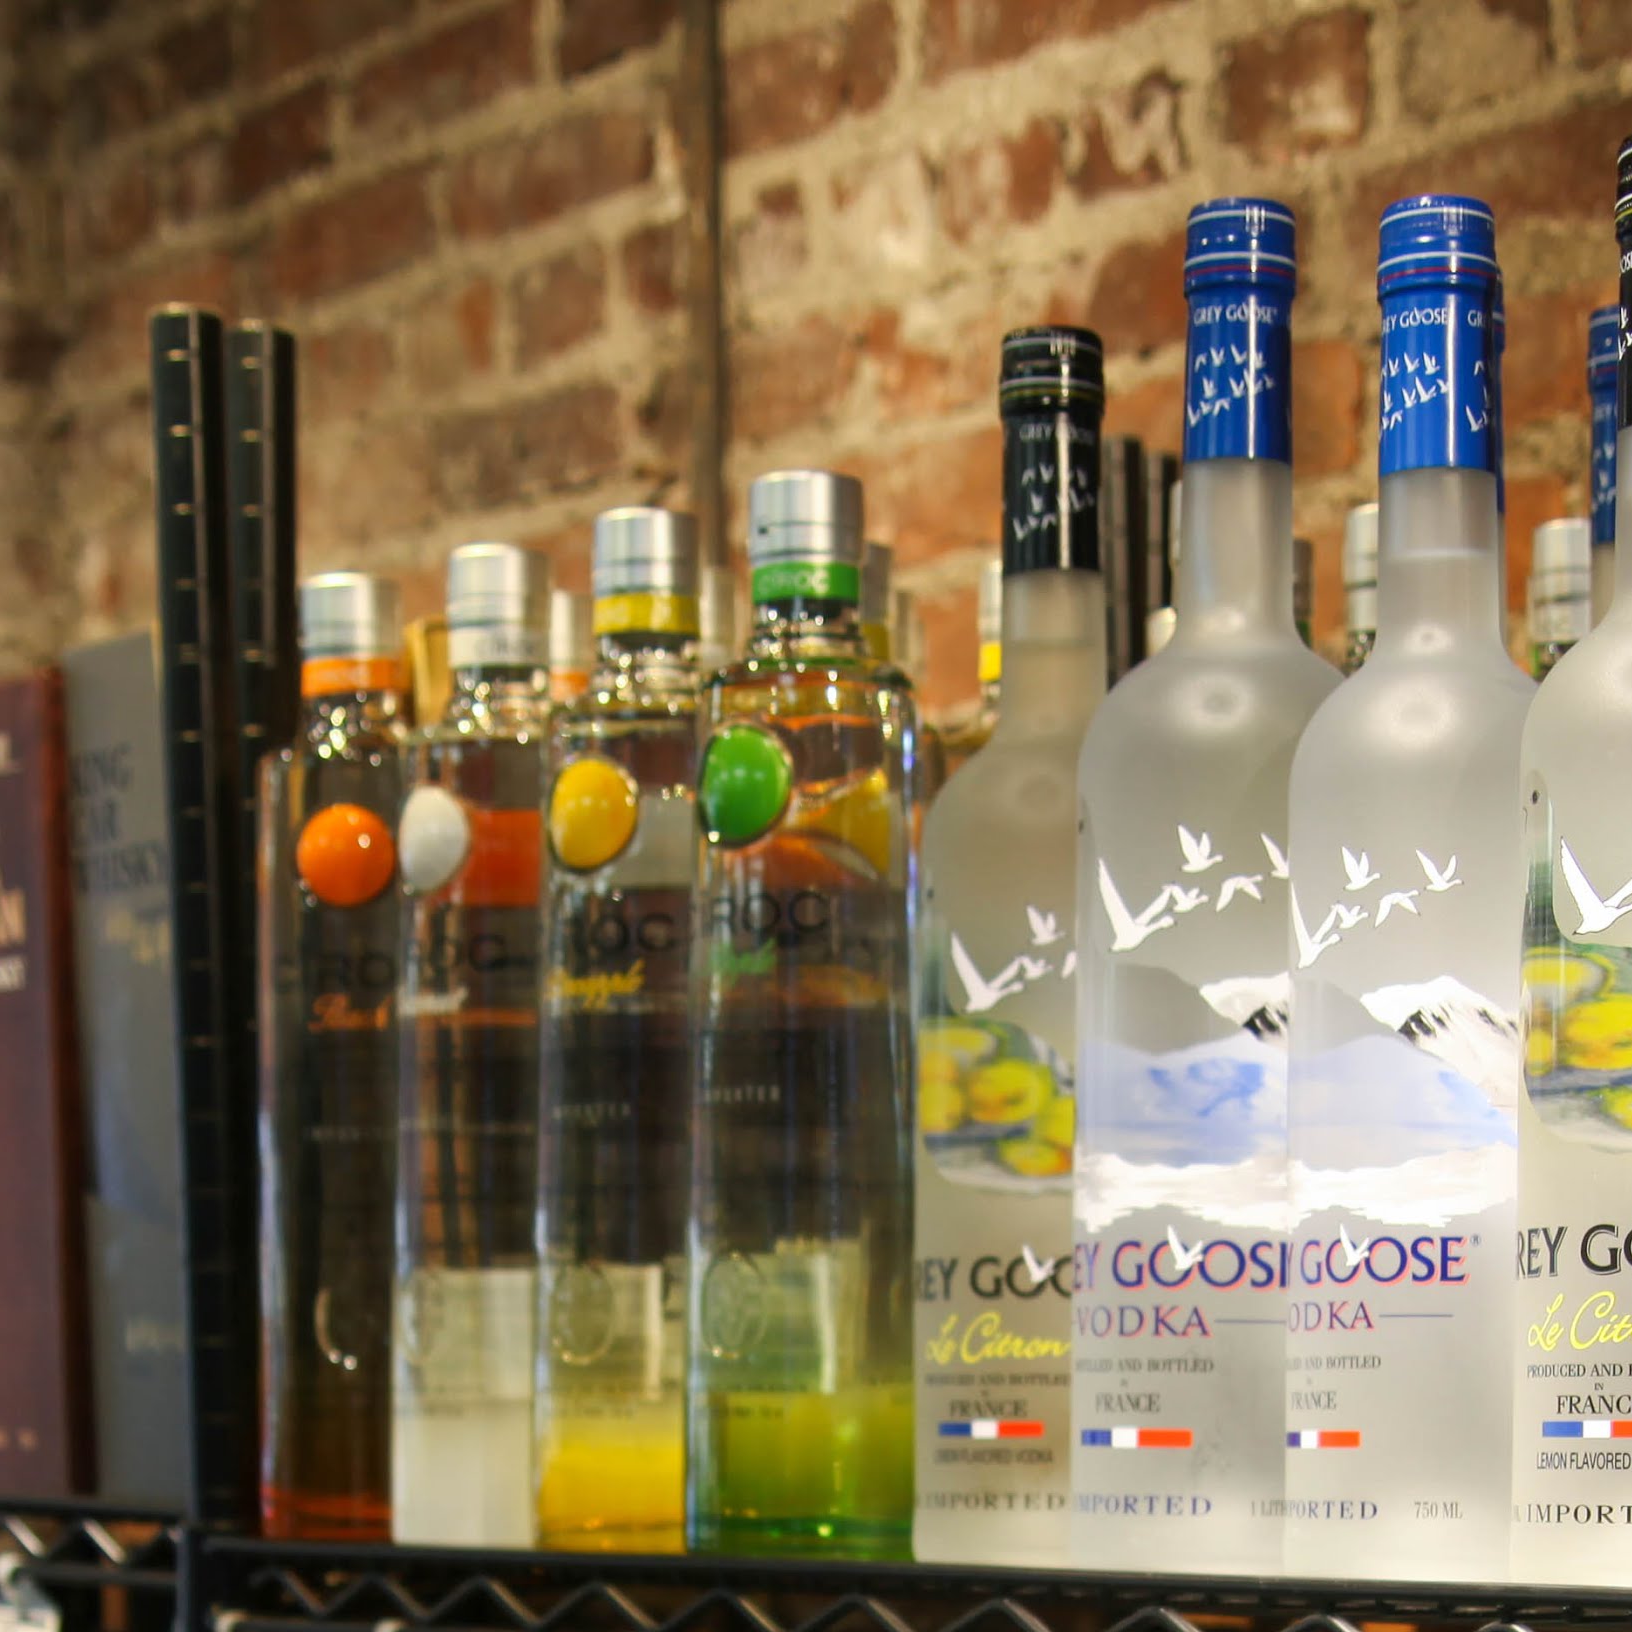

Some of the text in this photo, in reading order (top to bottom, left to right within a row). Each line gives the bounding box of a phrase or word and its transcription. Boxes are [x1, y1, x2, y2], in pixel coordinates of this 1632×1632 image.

[1193, 306, 1223, 325] GREY
[1299, 1235, 1472, 1290] GOOSE
[1515, 1225, 1564, 1280] REY
[1527, 1363, 1588, 1379] PRODUCED
[1590, 1363, 1624, 1378] AND
[1536, 1451, 1569, 1471] LEMON
[1570, 1451, 1632, 1471] FLAVORED
